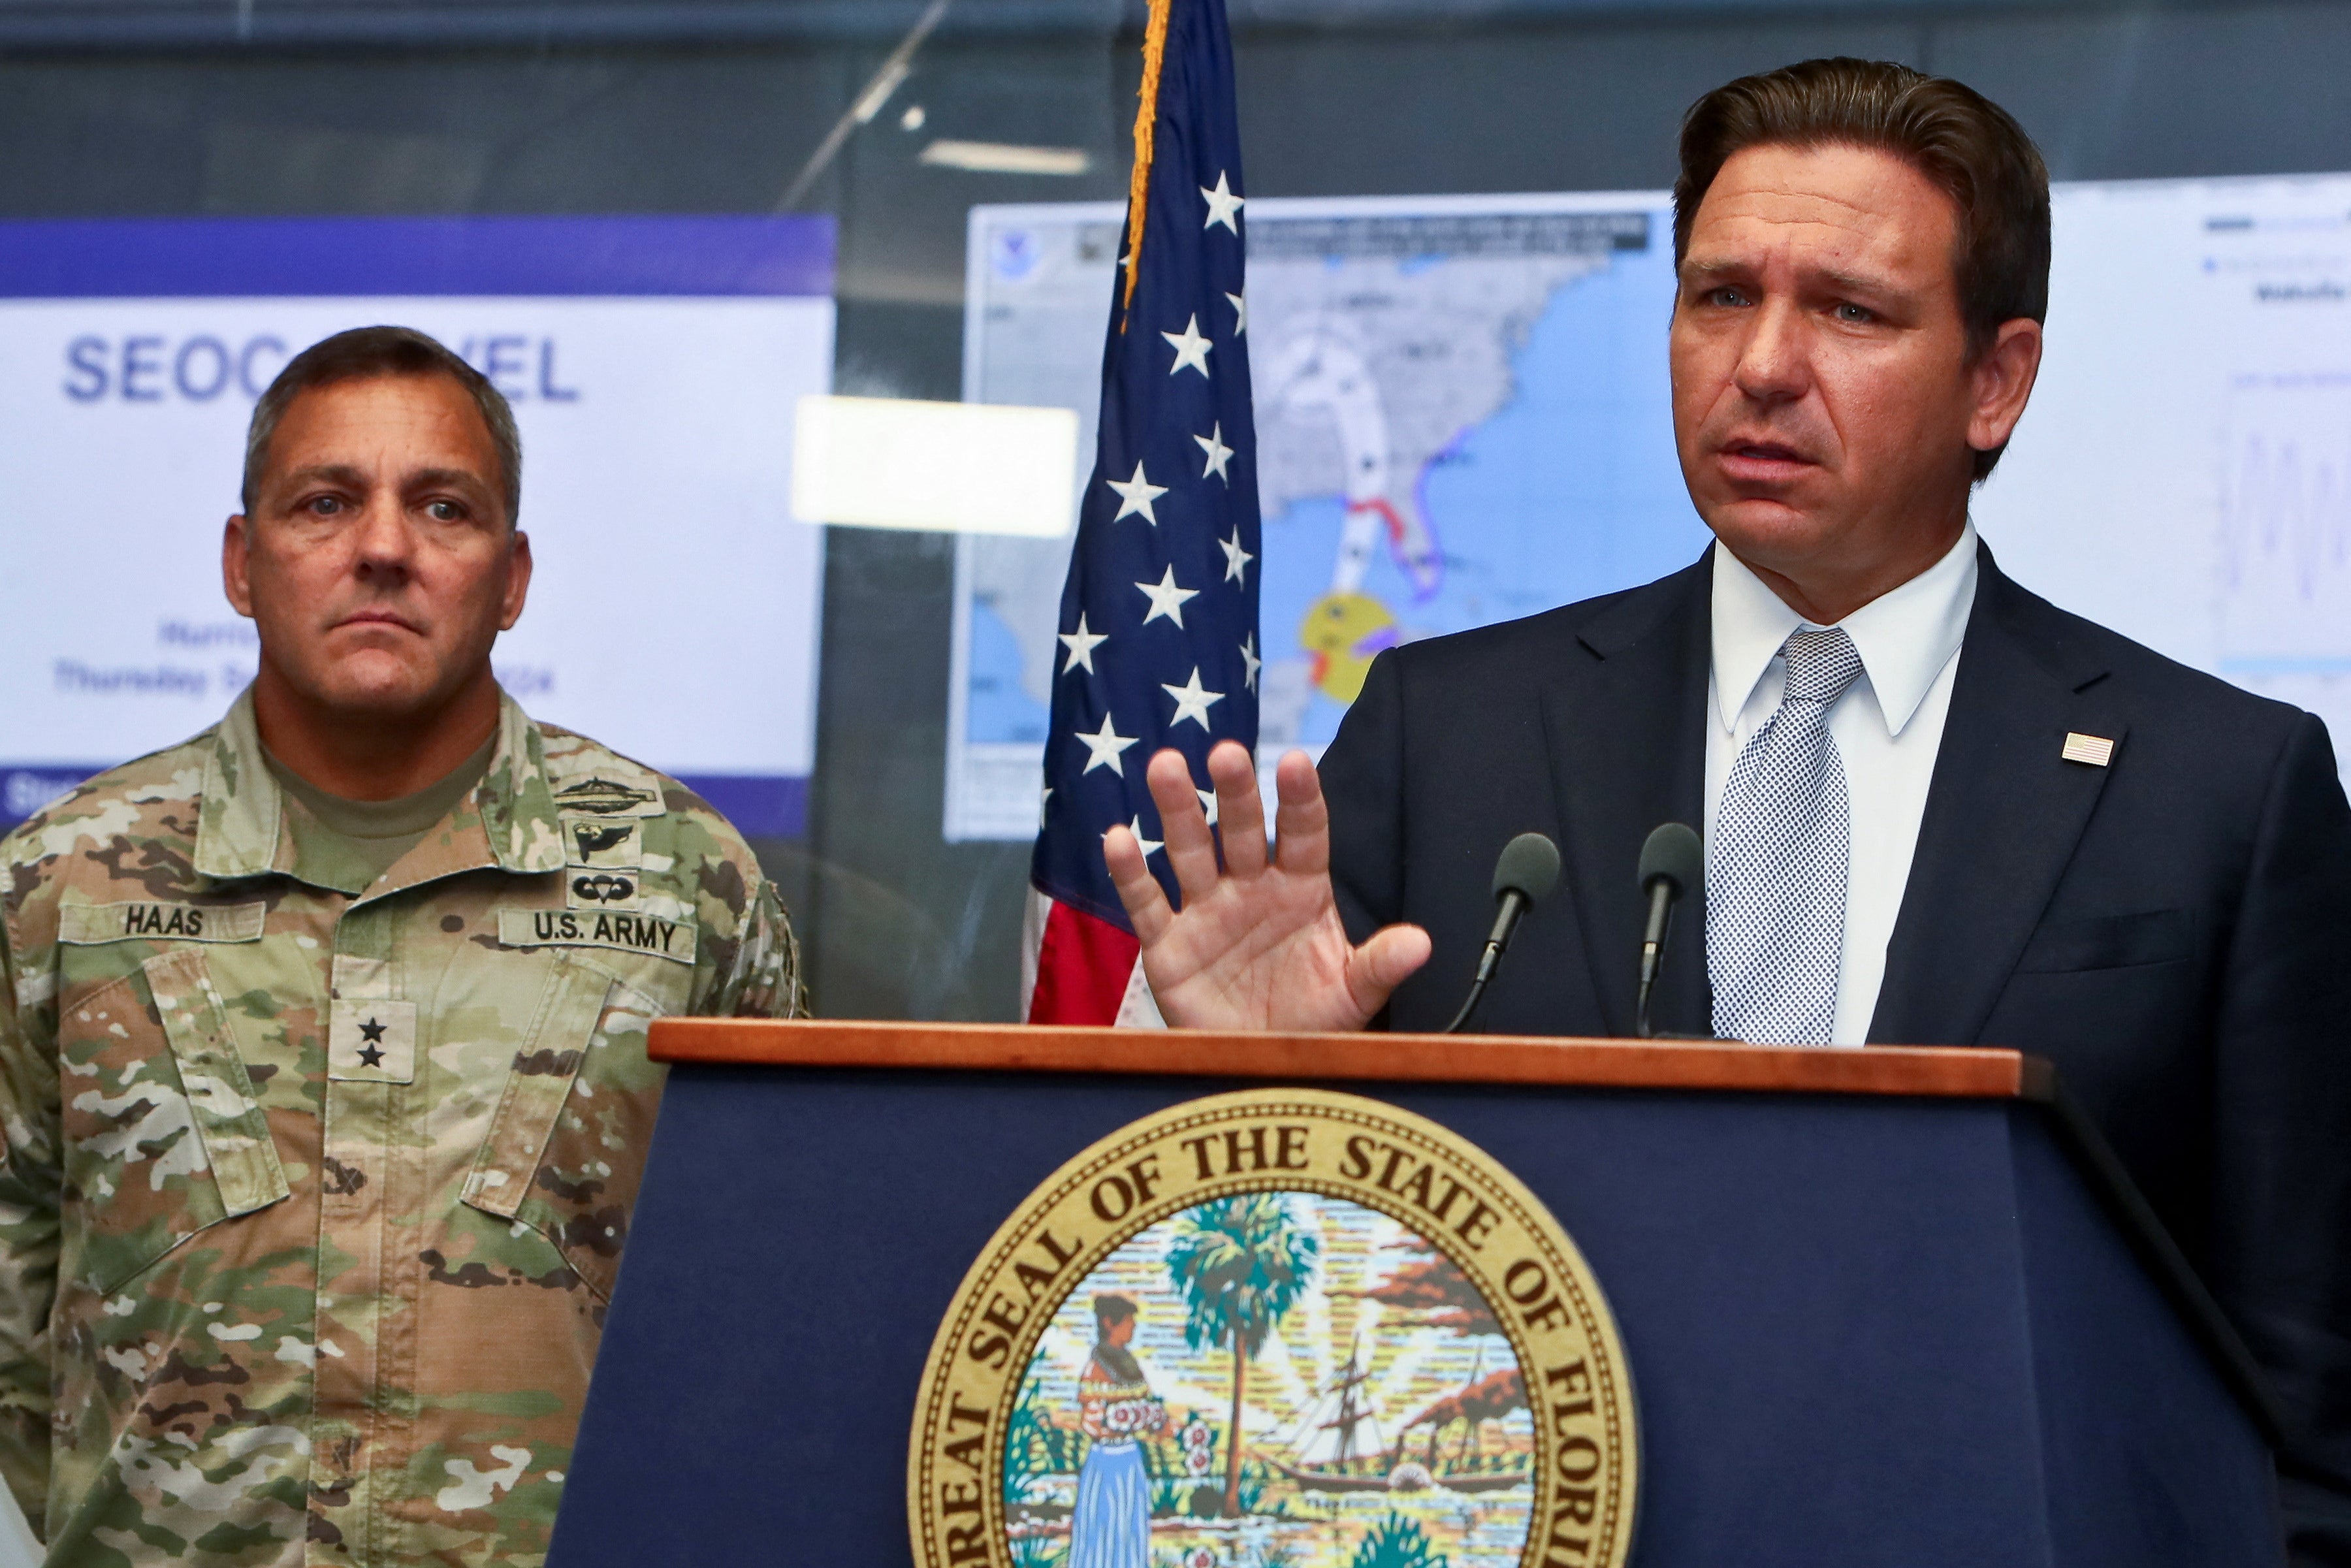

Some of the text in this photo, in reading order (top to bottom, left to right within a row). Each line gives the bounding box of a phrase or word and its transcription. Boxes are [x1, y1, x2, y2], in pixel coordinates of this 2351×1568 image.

[62, 334, 288, 405] SEOC
[125, 904, 204, 936] HAAS
[534, 912, 677, 952] U.S. ARMY
[942, 1125, 1601, 1568] REAT SEAL OF THE STATE OF FLORI
